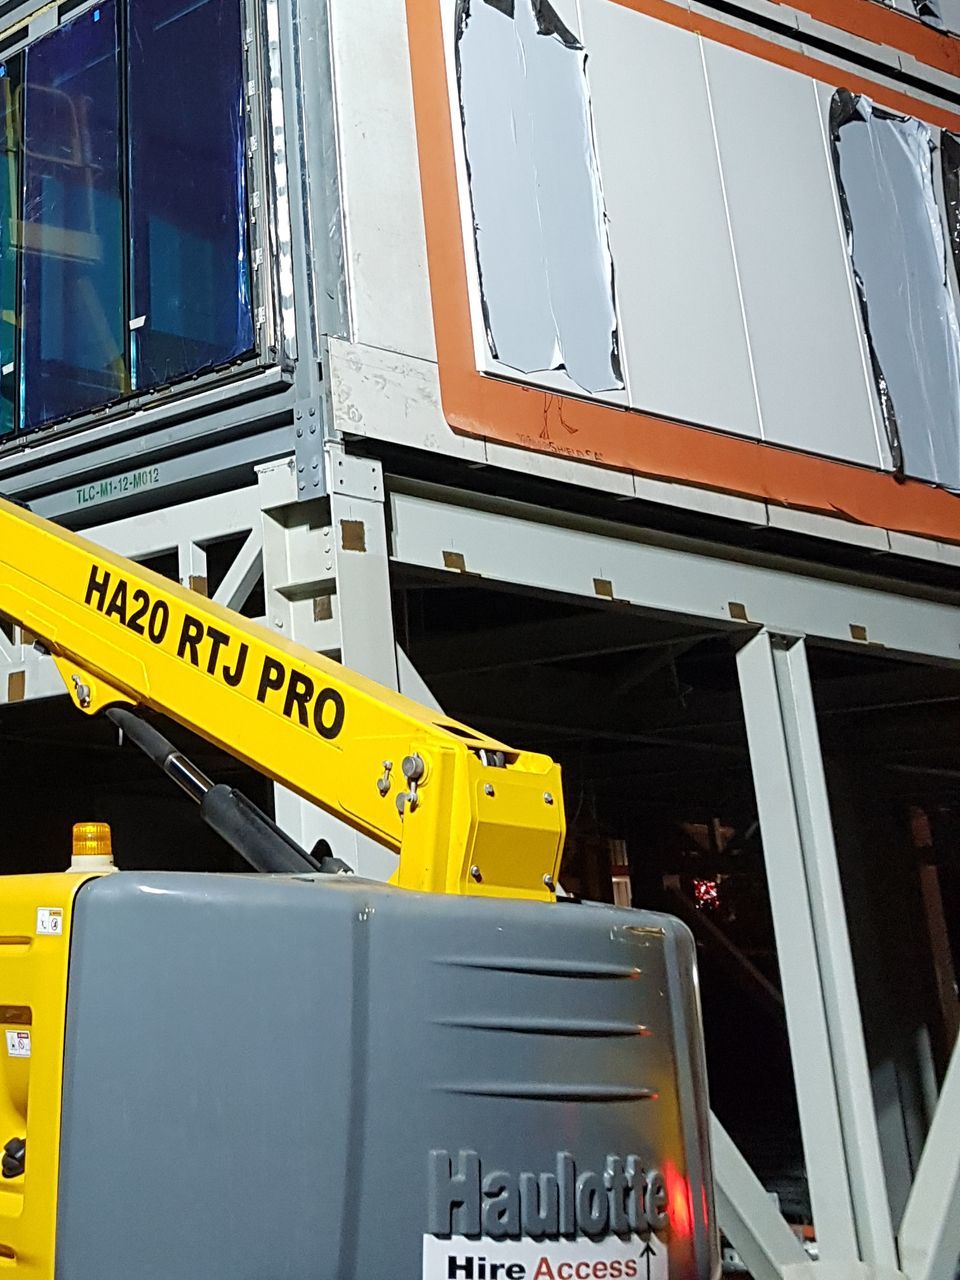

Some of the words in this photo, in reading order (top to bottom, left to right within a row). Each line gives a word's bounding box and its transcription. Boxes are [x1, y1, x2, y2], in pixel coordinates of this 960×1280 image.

[76, 468, 160, 505] TLC-M1-12-M012
[84, 564, 170, 645] HA20
[176, 613, 249, 688] RTJ
[256, 654, 346, 741] PRO
[428, 1148, 670, 1242] Haulotte
